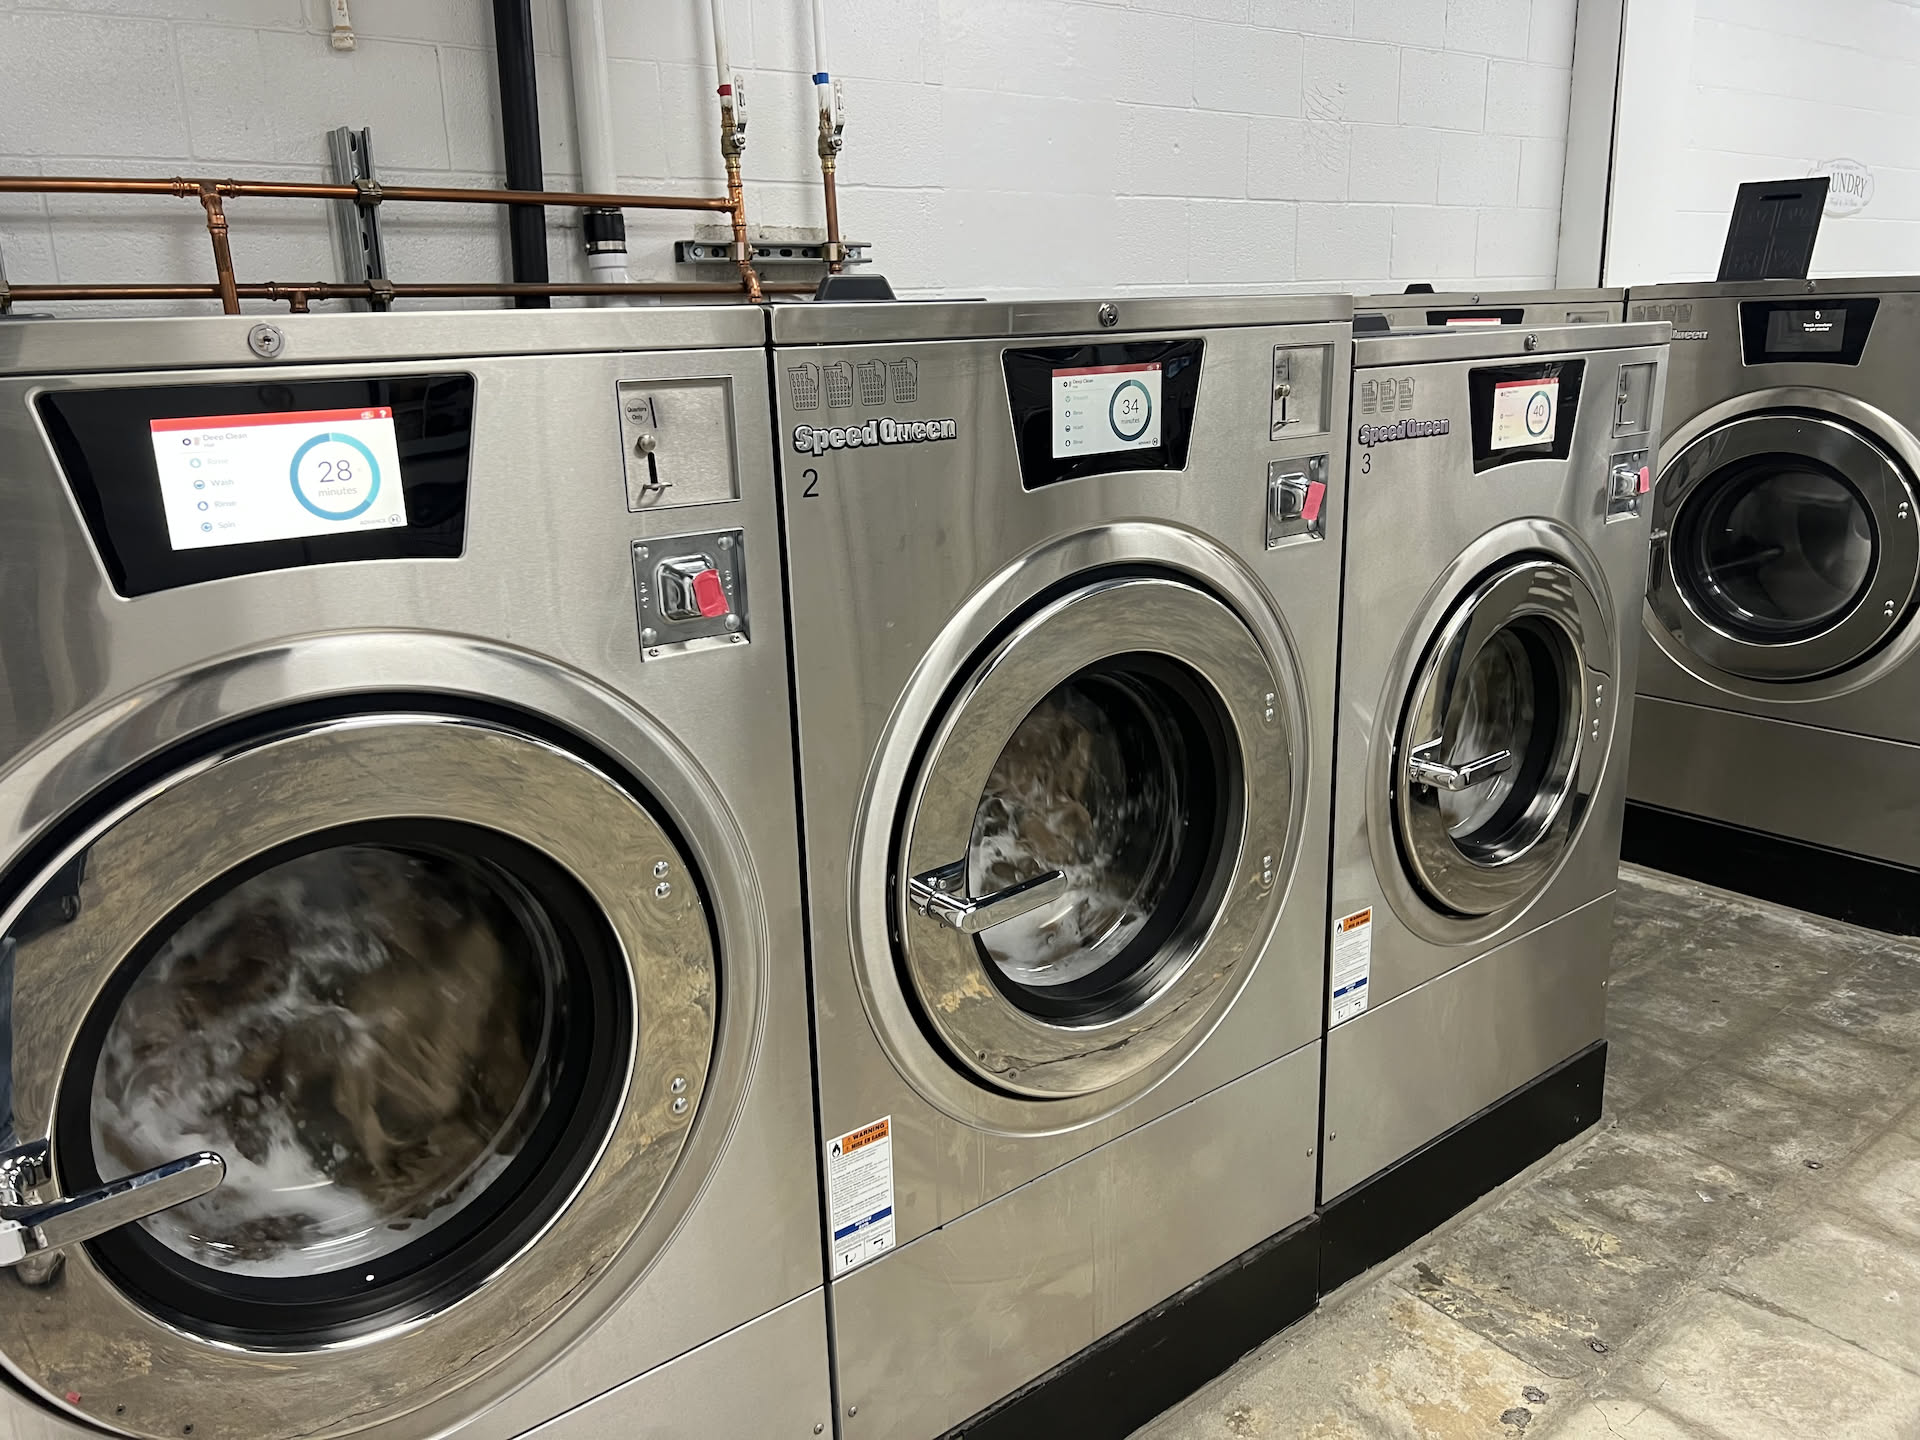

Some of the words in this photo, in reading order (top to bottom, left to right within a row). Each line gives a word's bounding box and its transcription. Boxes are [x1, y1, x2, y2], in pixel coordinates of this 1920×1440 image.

[1122, 399, 1139, 415] 34
[1533, 404, 1544, 417] 40
[318, 460, 352, 483] 28
[1362, 453, 1371, 474] 3
[318, 487, 358, 497] minutes
[802, 469, 819, 498] 2
[853, 1122, 885, 1140] WARNING
